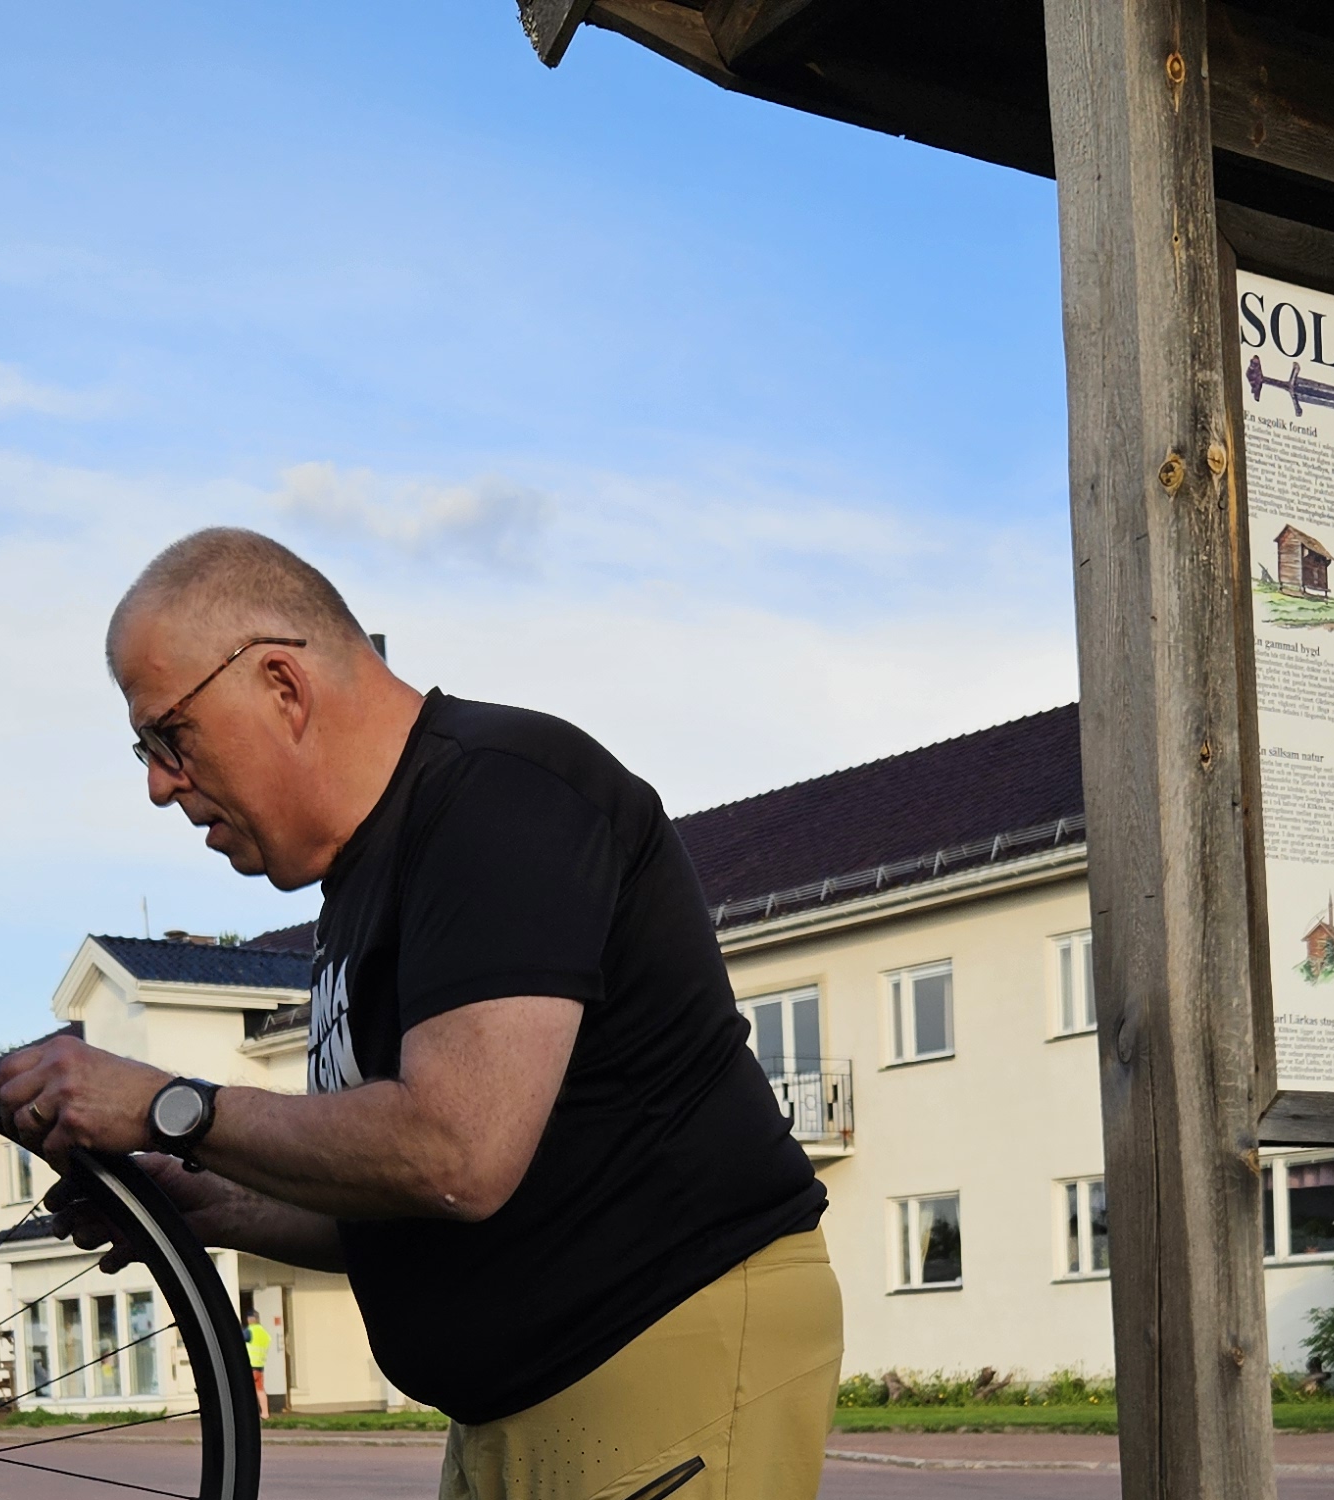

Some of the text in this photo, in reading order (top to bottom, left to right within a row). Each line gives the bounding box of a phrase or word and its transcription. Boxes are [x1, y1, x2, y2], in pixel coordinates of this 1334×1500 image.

[1243, 410, 1317, 437] En sagolik forntid
[1265, 640, 1298, 654] gammal
[1301, 644, 1320, 657] bygd
[1269, 747, 1299, 761] sällsam
[1302, 752, 1324, 763] natur
[1289, 1015, 1317, 1028] Lärkas
